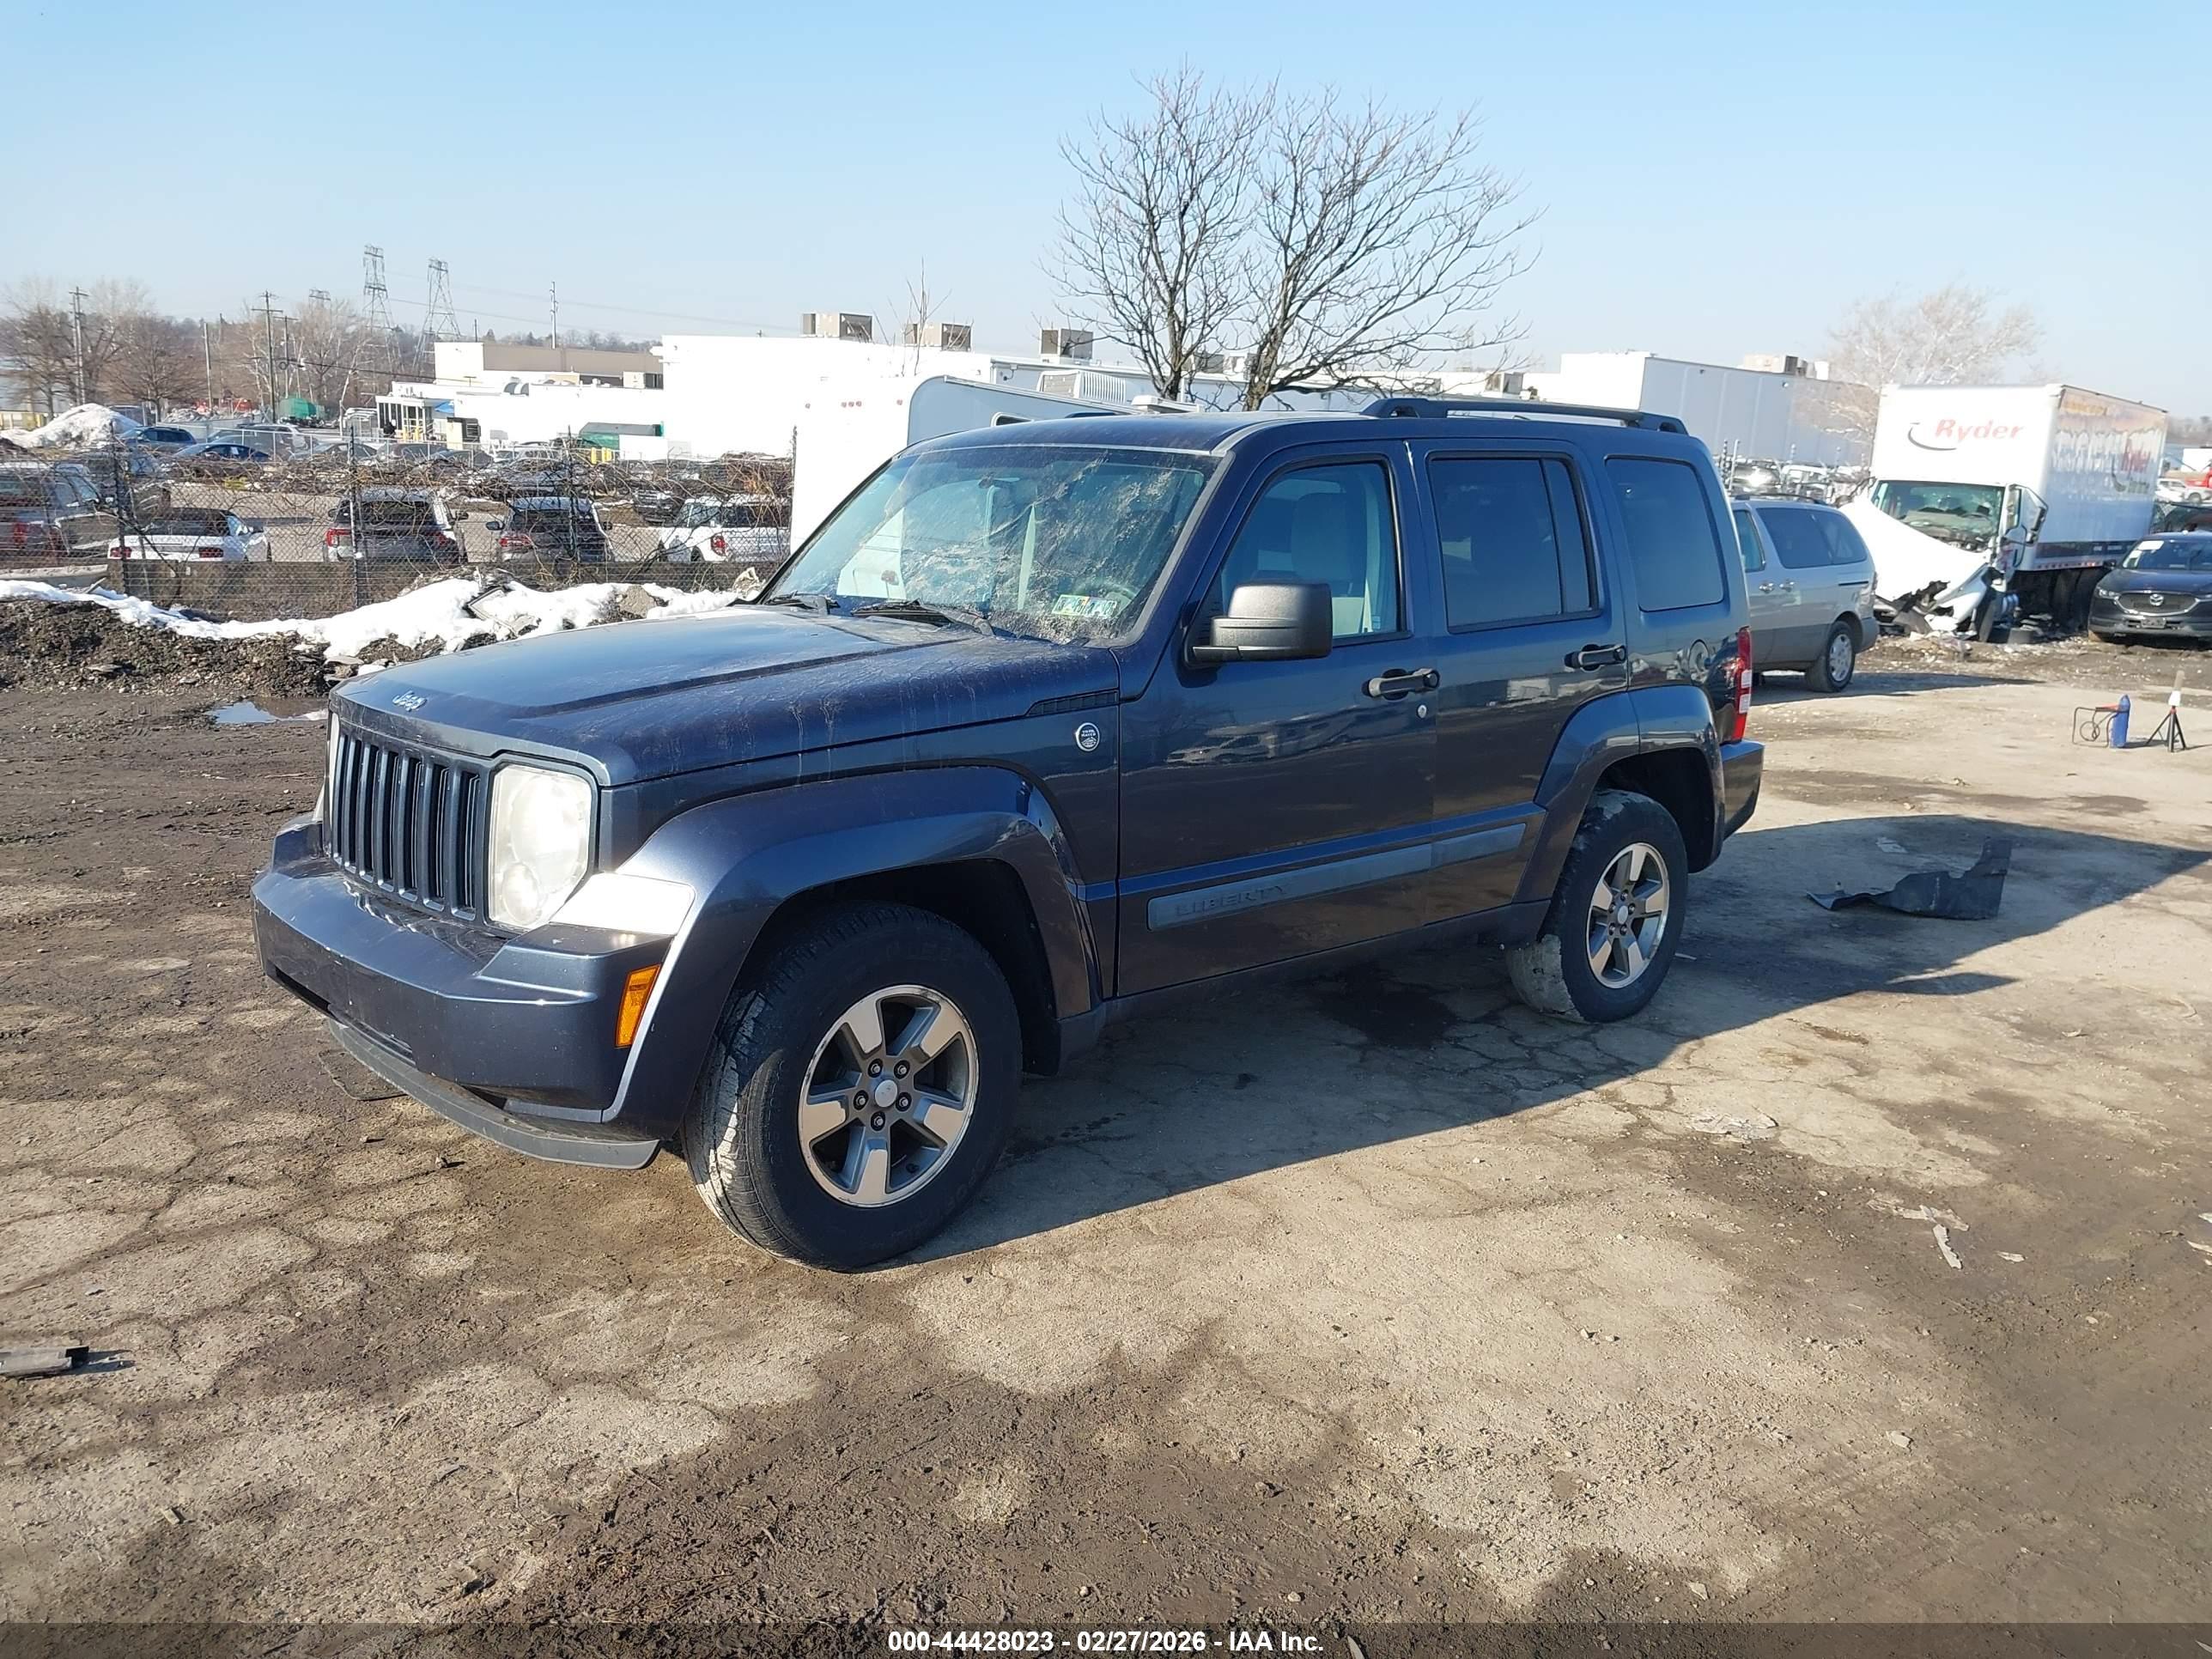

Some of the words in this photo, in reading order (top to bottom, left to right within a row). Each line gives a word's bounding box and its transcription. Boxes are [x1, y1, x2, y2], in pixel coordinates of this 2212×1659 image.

[1935, 418, 2025, 443] Ryder
[392, 690, 428, 712] Jeep
[1176, 885, 1287, 916] LIBERTY
